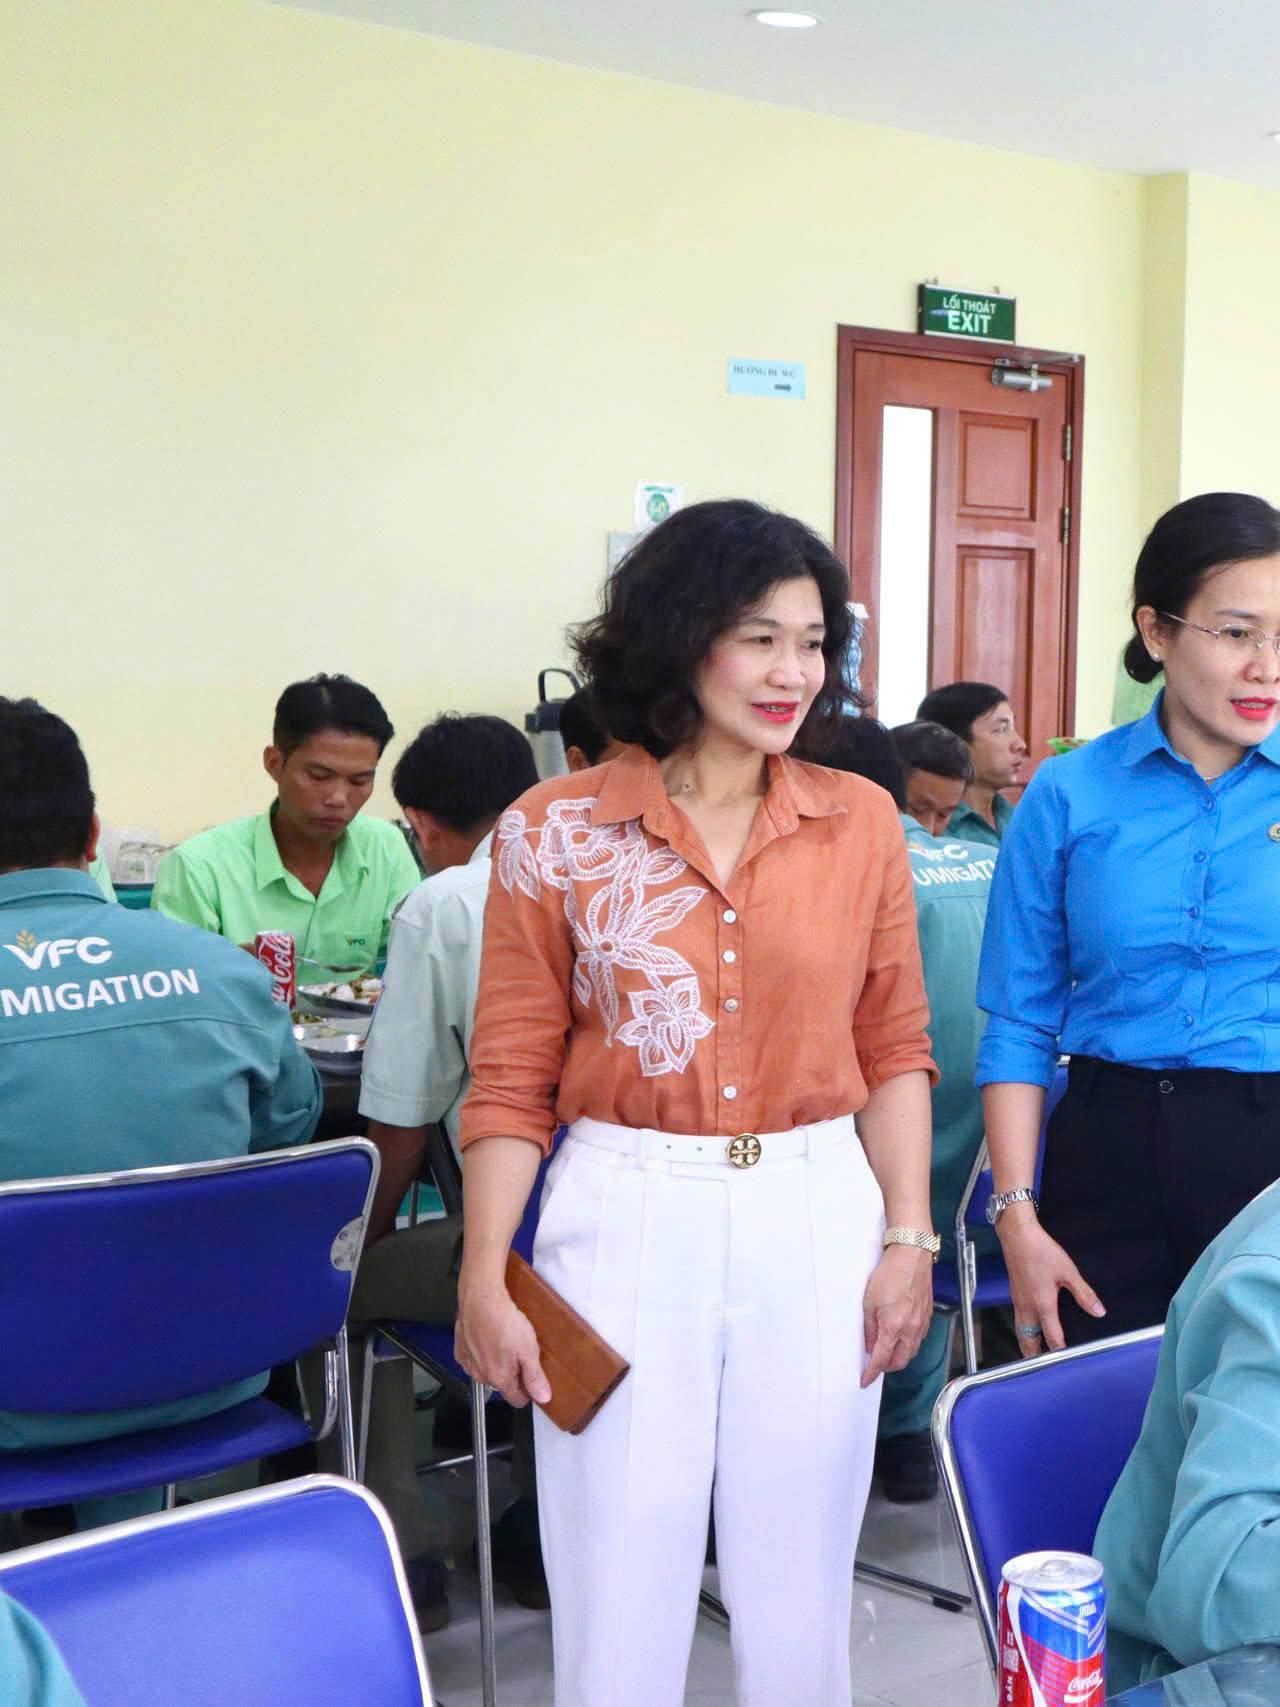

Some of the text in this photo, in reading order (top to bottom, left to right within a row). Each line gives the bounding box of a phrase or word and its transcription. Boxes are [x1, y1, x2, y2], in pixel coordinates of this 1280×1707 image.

[943, 294, 996, 314] LỐI THOÁT
[948, 309, 992, 334] EXIT
[2, 936, 113, 970] VFC
[0, 968, 200, 1017] MIGATION
